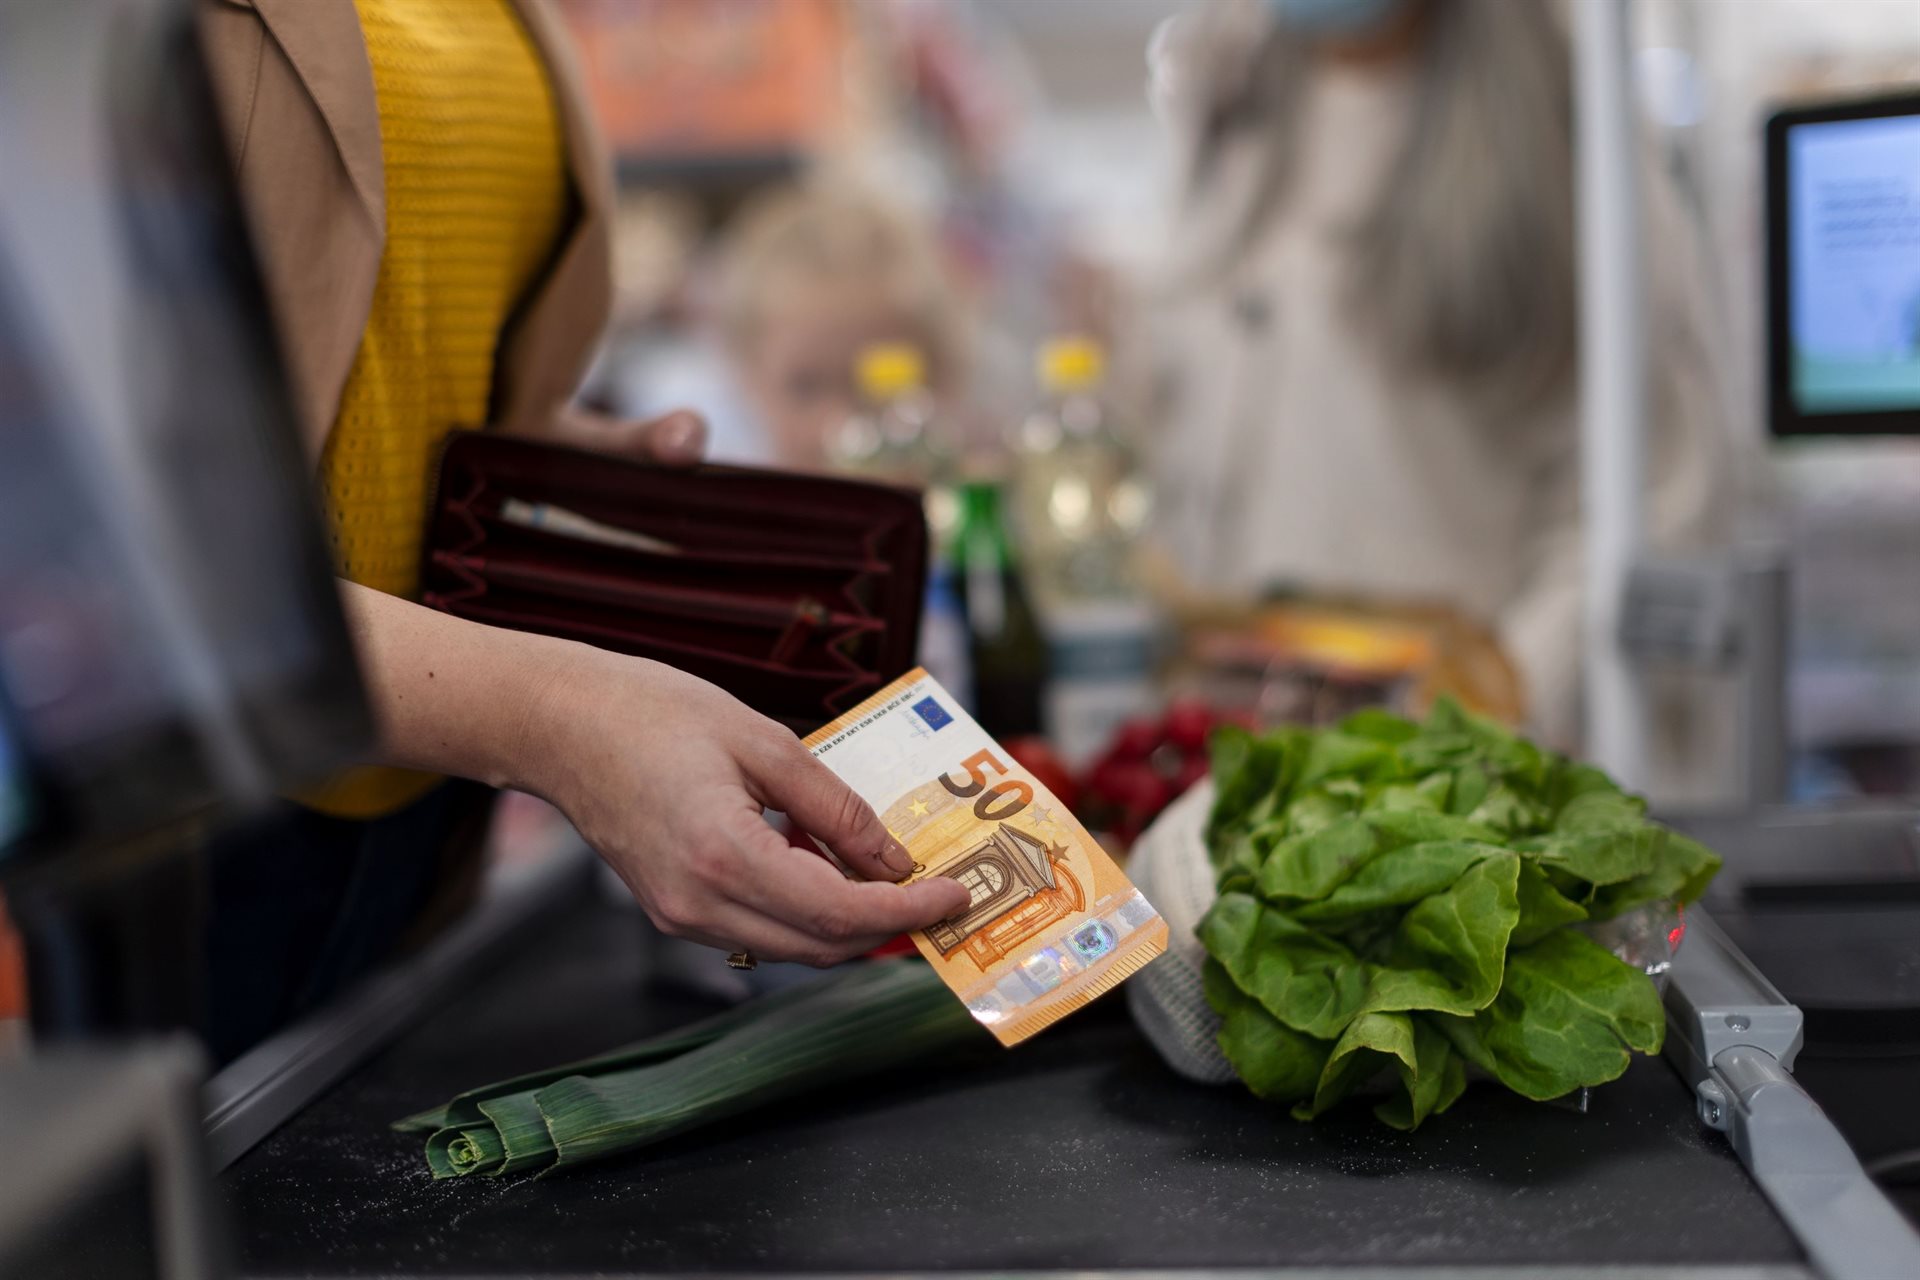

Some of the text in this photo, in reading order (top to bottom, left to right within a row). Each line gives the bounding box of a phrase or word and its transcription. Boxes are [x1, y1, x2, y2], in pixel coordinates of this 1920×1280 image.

[819, 743, 833, 754] EZB
[832, 734, 846, 745] EKP
[846, 725, 860, 737] EKT
[938, 748, 1034, 821] 50
